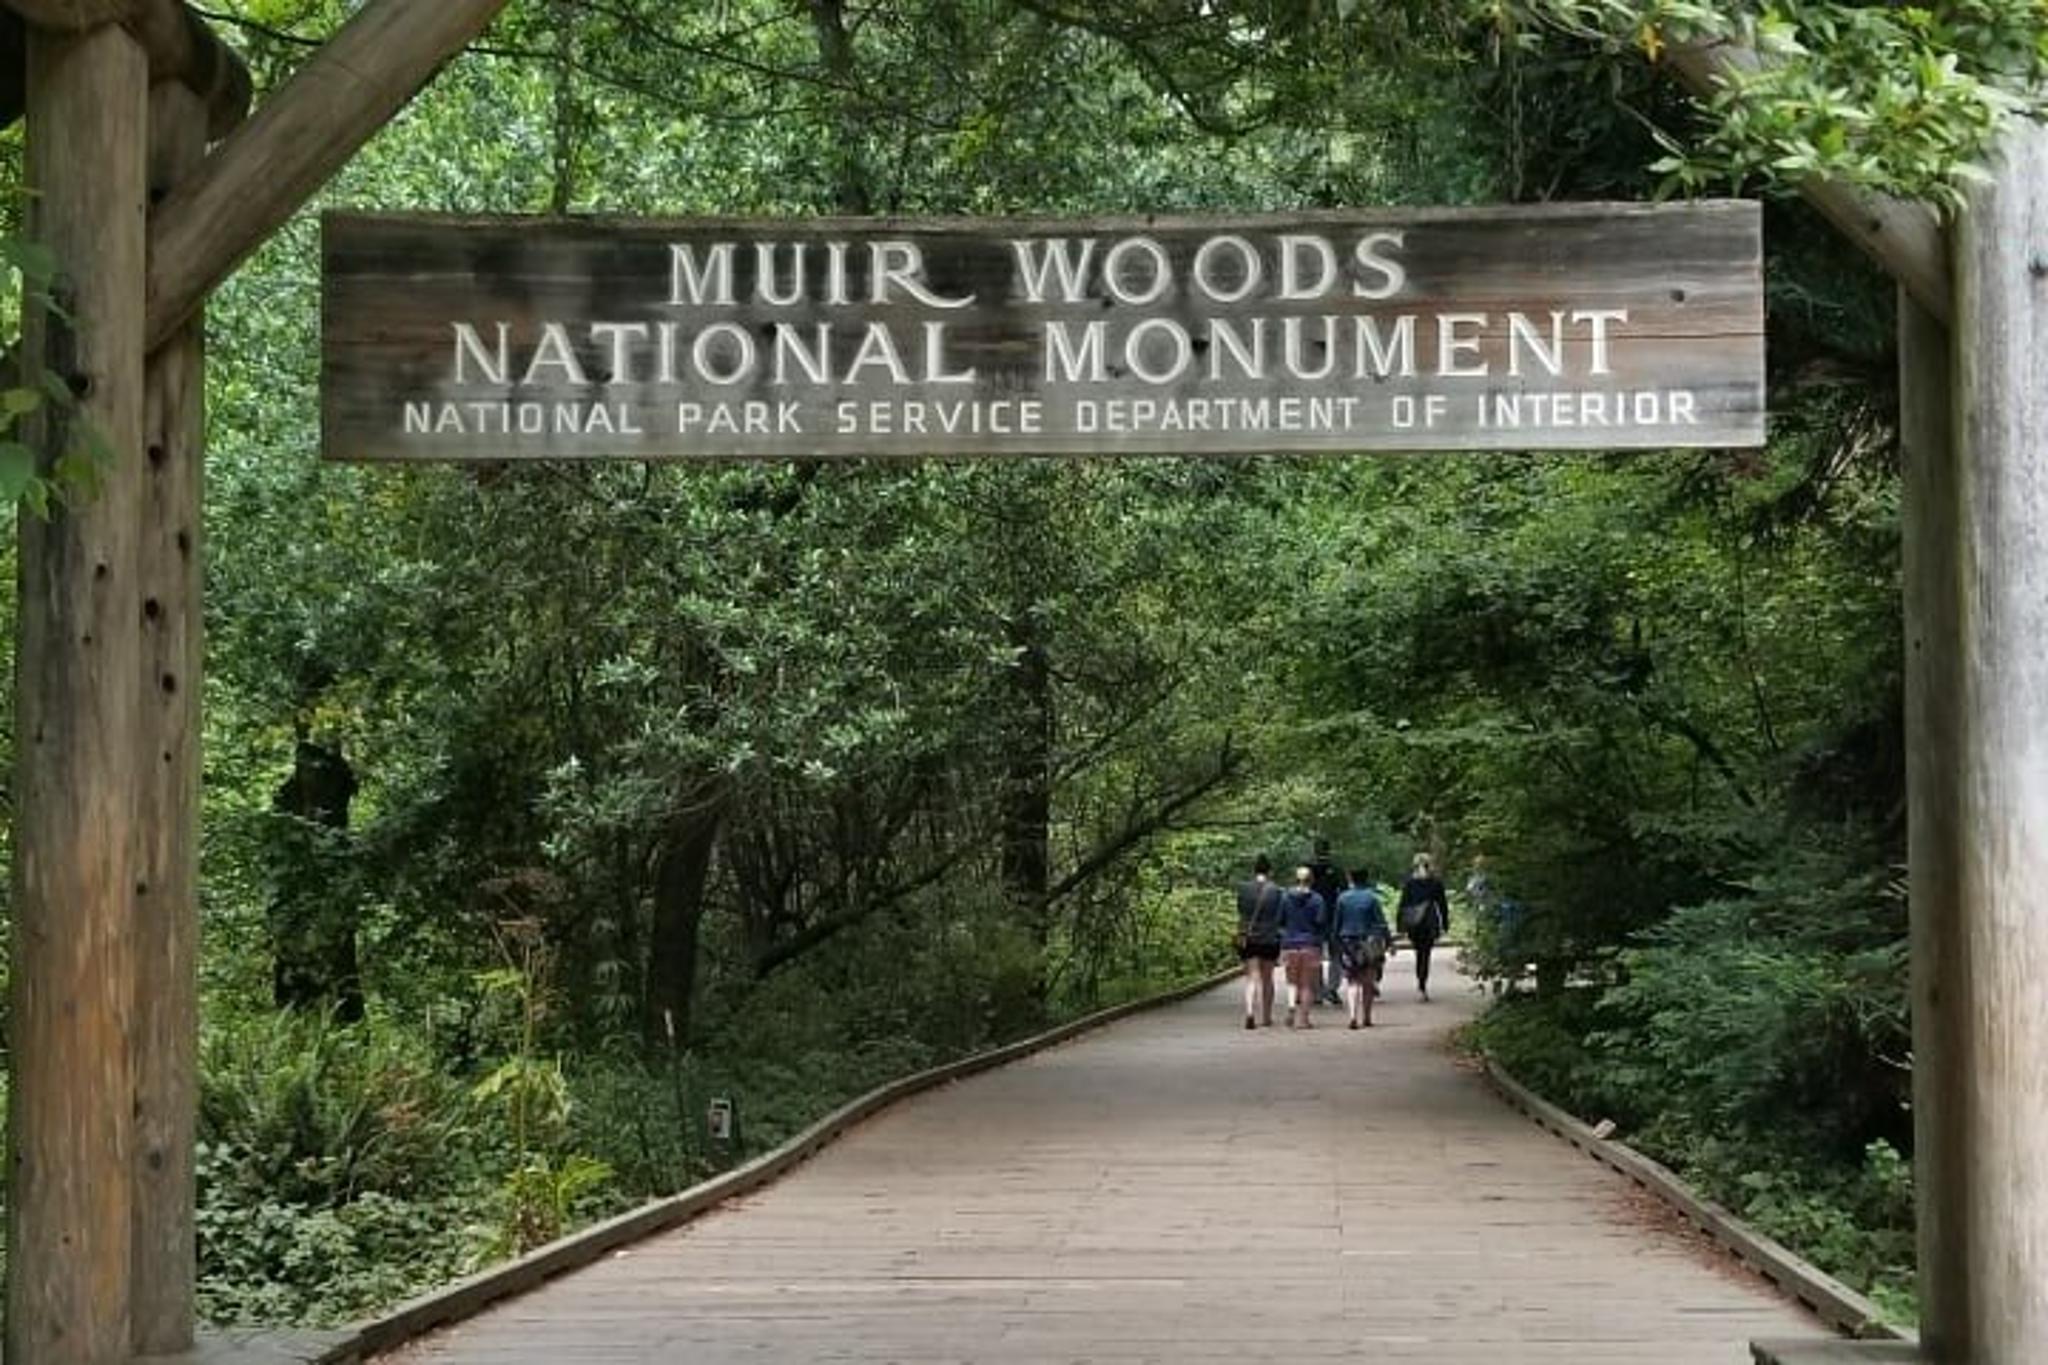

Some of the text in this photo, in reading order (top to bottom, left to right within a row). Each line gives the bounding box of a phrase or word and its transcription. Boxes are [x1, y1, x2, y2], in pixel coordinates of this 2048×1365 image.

[668, 233, 1407, 308] MUIR WOODS
[451, 308, 1629, 385] NATIONAL MONUMENT
[403, 391, 1699, 434] NATIONAL PARK SERVICE DEPARTMENT OF INTERIOR
